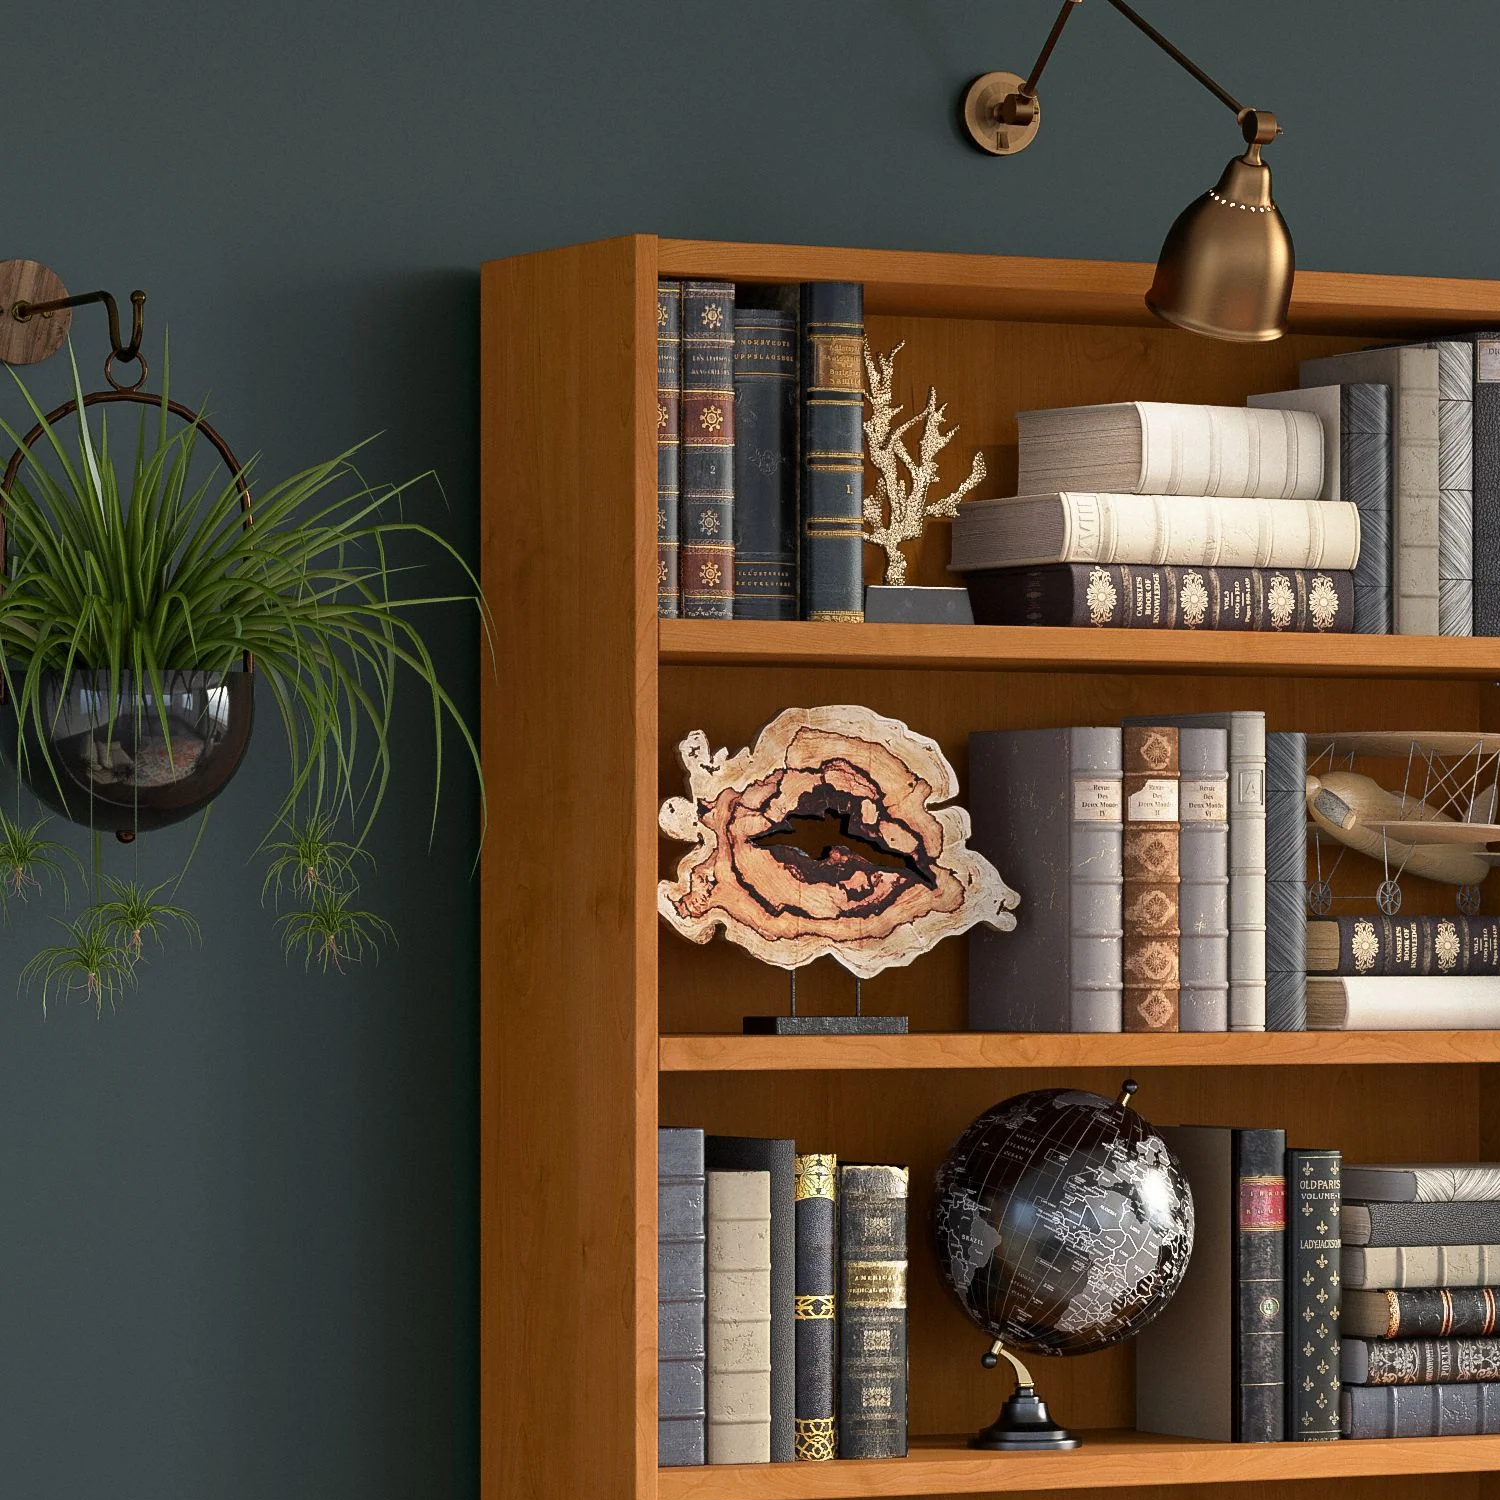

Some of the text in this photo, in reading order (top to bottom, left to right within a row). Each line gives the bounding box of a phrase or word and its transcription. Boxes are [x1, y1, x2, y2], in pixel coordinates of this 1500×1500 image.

[709, 465, 716, 475] 2
[1145, 578, 1151, 589] OF
[1404, 928, 1410, 937] OF
[1299, 1180, 1341, 1189] OLD PARIS
[961, 1233, 984, 1247] BRAZIL
[1439, 1344, 1451, 1376] POEMS
